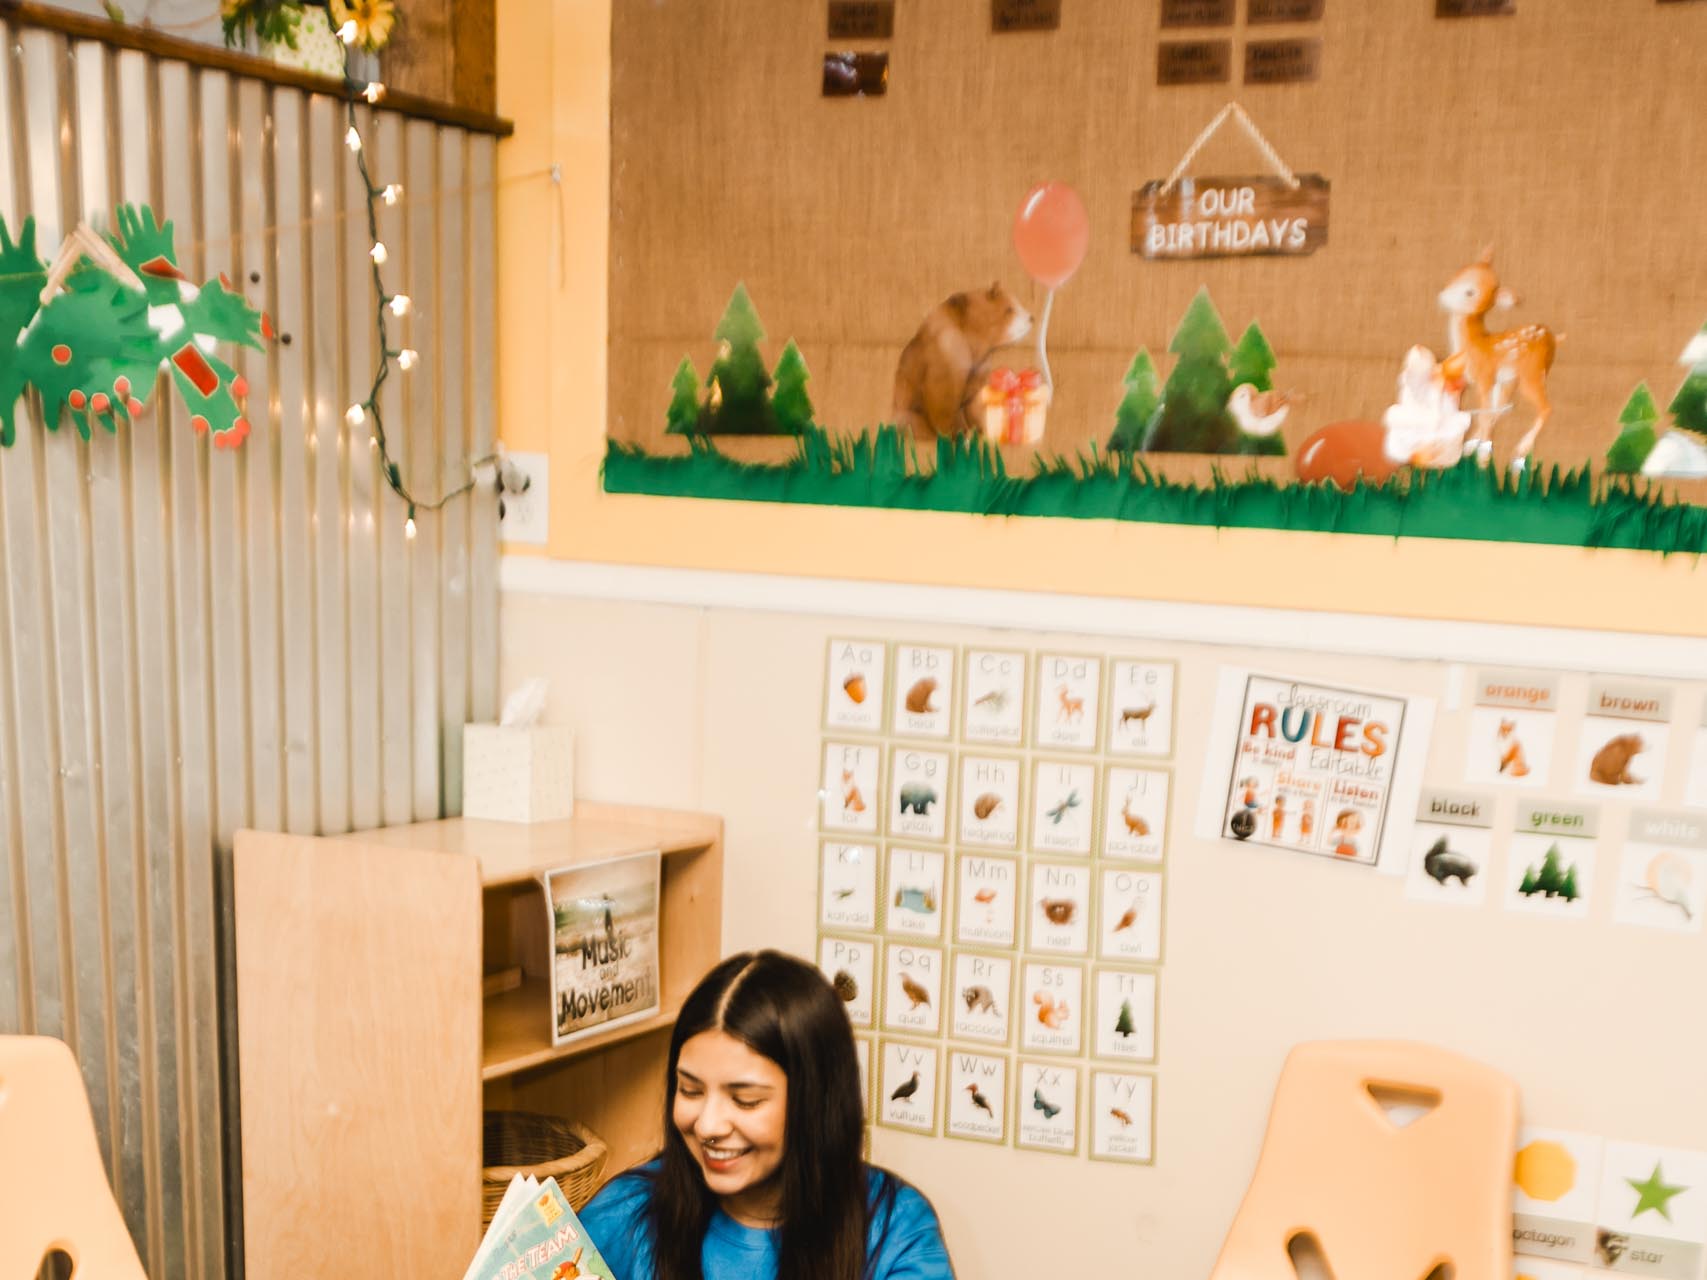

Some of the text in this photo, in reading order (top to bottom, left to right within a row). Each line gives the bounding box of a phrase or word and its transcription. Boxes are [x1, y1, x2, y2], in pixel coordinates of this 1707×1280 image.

[1200, 187, 1256, 217] OUR
[1151, 218, 1309, 251] BIRTHDAYS
[1485, 684, 1550, 703] orange
[1599, 691, 1660, 712] brown
[1249, 702, 1389, 758] RULES
[1431, 800, 1480, 818] black
[1531, 811, 1585, 827] green
[1646, 820, 1698, 838] white
[581, 932, 632, 970] Music
[600, 963, 619, 980] and
[560, 967, 652, 1025] Movement
[525, 1225, 580, 1268] TEAM
[1631, 1250, 1664, 1264] star
